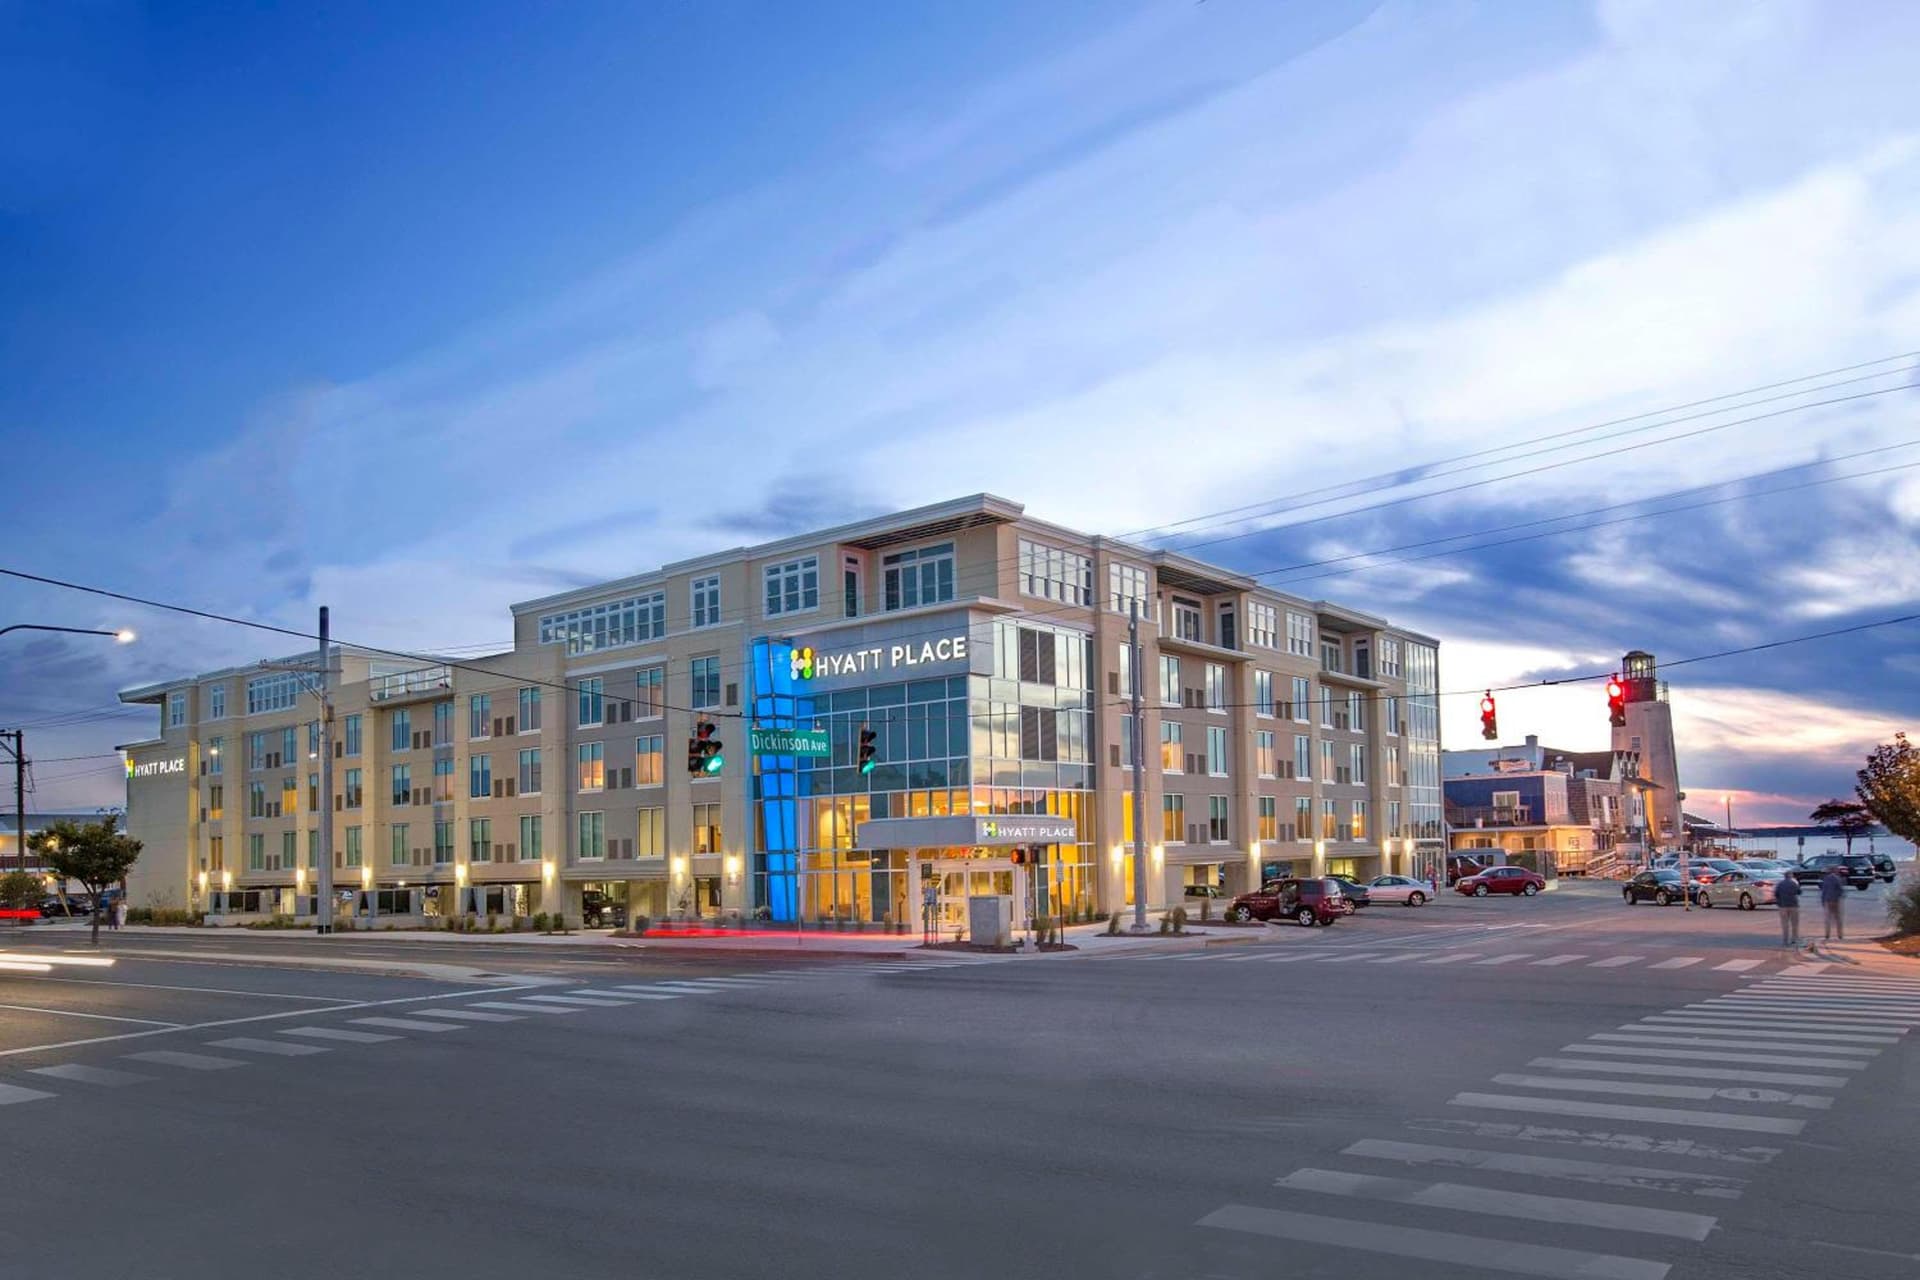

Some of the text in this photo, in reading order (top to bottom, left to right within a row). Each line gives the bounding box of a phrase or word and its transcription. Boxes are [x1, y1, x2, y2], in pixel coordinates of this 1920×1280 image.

[816, 636, 967, 677] HYATT PLACE
[752, 733, 827, 752] Dickinson Ave
[135, 758, 185, 777] HYATT PLACE
[999, 827, 1075, 837] HYATT PLACE
